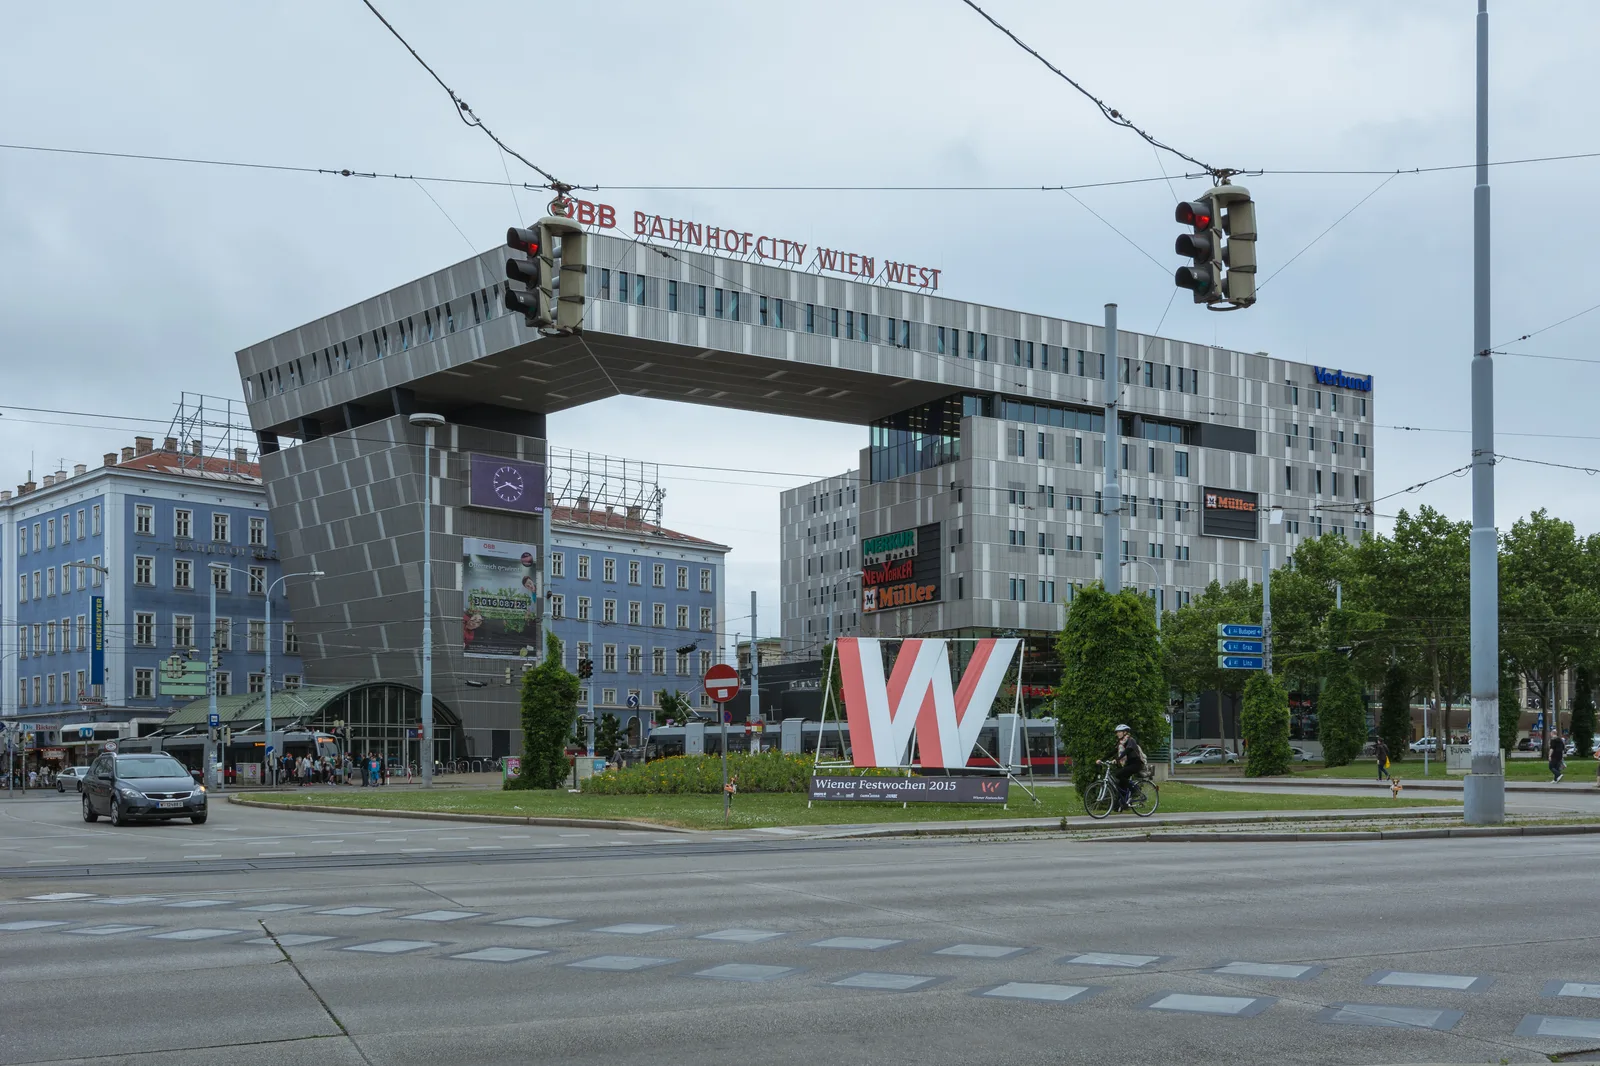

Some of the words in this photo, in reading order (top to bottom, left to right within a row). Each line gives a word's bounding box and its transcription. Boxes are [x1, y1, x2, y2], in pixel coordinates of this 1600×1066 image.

[633, 210, 807, 265] BAHNHOFCITY
[816, 246, 875, 279] WIEN
[884, 259, 941, 290] WEST
[1314, 366, 1372, 392] Verbund
[1218, 496, 1256, 512] Müller
[864, 530, 915, 556] MERKUR
[885, 548, 915, 561] Markt
[879, 582, 936, 608] Müller
[815, 779, 857, 789] Wiener
[858, 779, 926, 790] Festwochen
[928, 781, 957, 791] 2015
